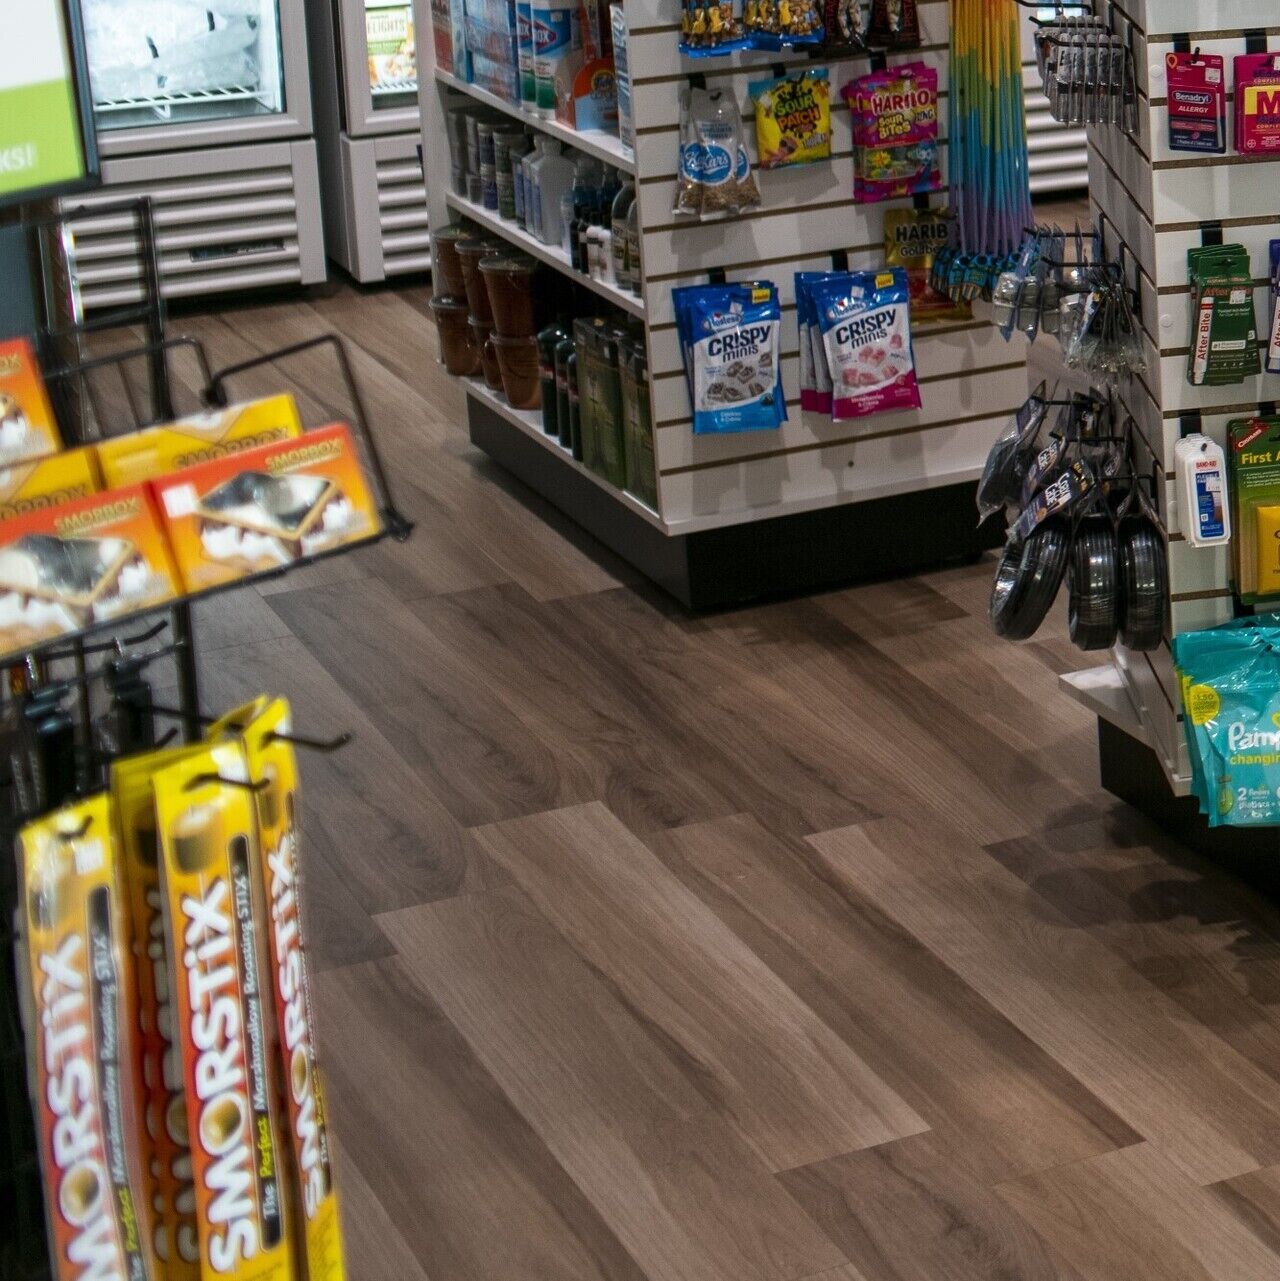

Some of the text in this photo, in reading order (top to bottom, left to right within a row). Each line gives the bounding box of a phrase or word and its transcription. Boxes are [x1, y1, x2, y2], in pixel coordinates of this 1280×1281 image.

[775, 96, 815, 118] SOUR
[1175, 92, 1209, 103] Benadryl
[777, 108, 821, 129] PATCH
[1178, 105, 1209, 113] ALLERGY
[852, 329, 888, 349] minis
[1197, 312, 1211, 361] After Bite
[723, 344, 759, 363] minis
[1196, 460, 1217, 470] BAND-AID
[1241, 450, 1273, 465] First
[1237, 788, 1247, 802] 2
[239, 918, 259, 993] Roasting
[246, 992, 270, 1111] Marshmallow
[255, 1116, 273, 1180] Perfect
[259, 1187, 278, 1221] The
